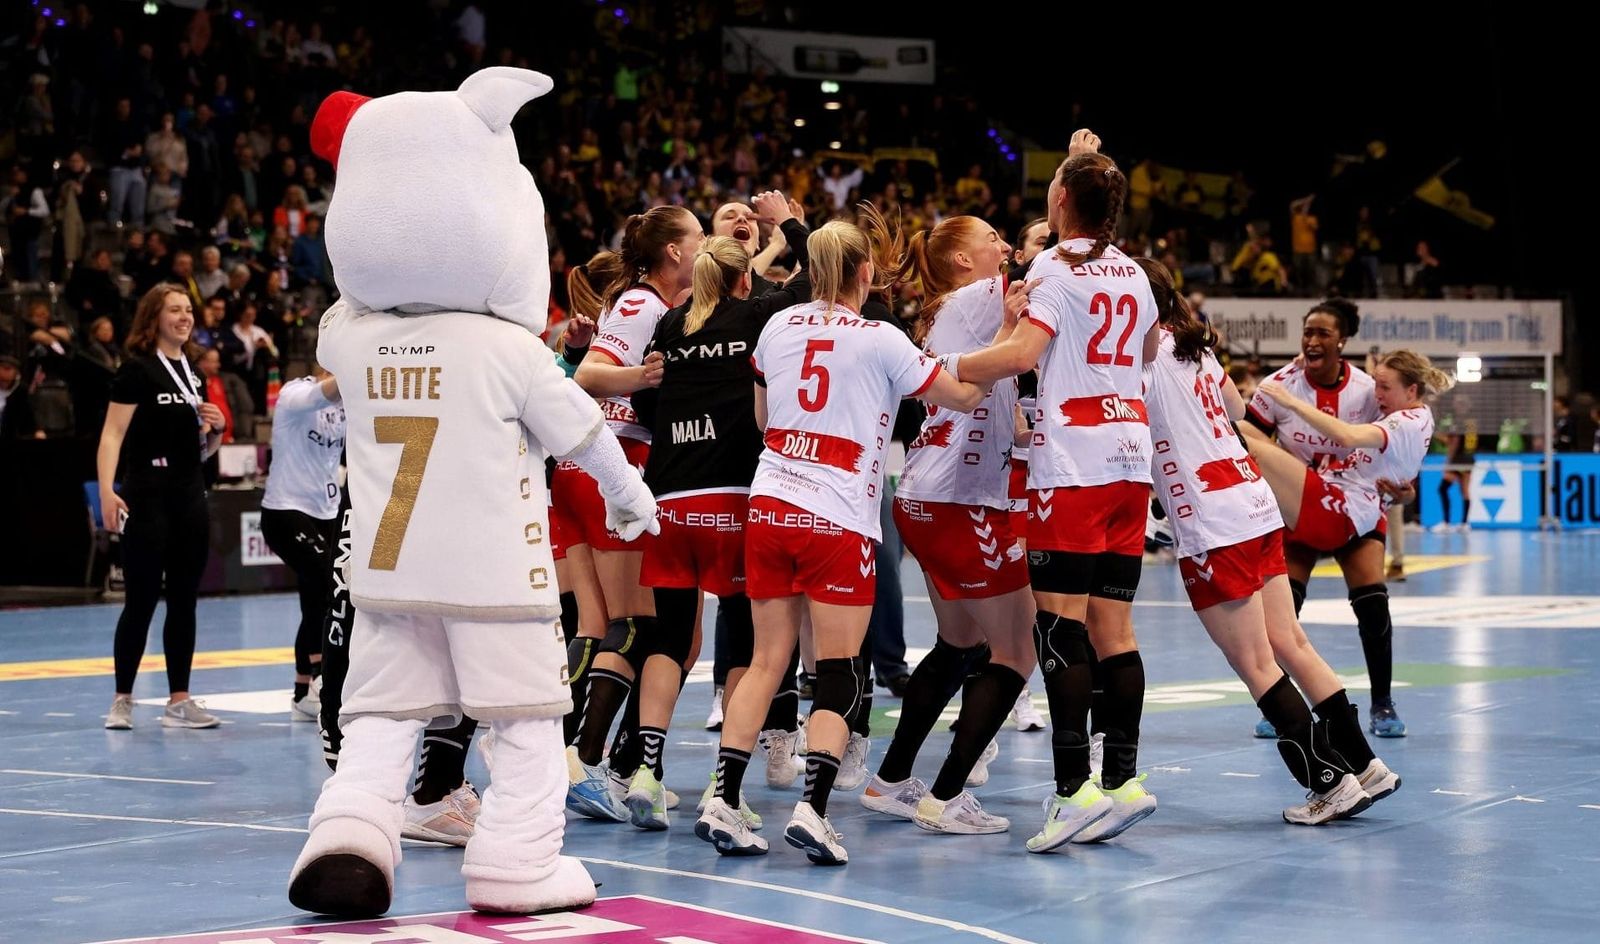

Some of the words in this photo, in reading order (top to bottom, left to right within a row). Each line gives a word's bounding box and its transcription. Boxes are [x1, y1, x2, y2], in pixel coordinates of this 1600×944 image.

[1070, 264, 1137, 278] OLYMP
[1086, 292, 1138, 367] 22
[378, 345, 435, 355] OLYMP
[662, 340, 747, 362] LYMP
[366, 366, 442, 400] LOTTE
[797, 338, 834, 412] 5
[781, 431, 820, 462] DÖLL
[368, 416, 439, 571] 7
[812, 528, 843, 537] concepts
